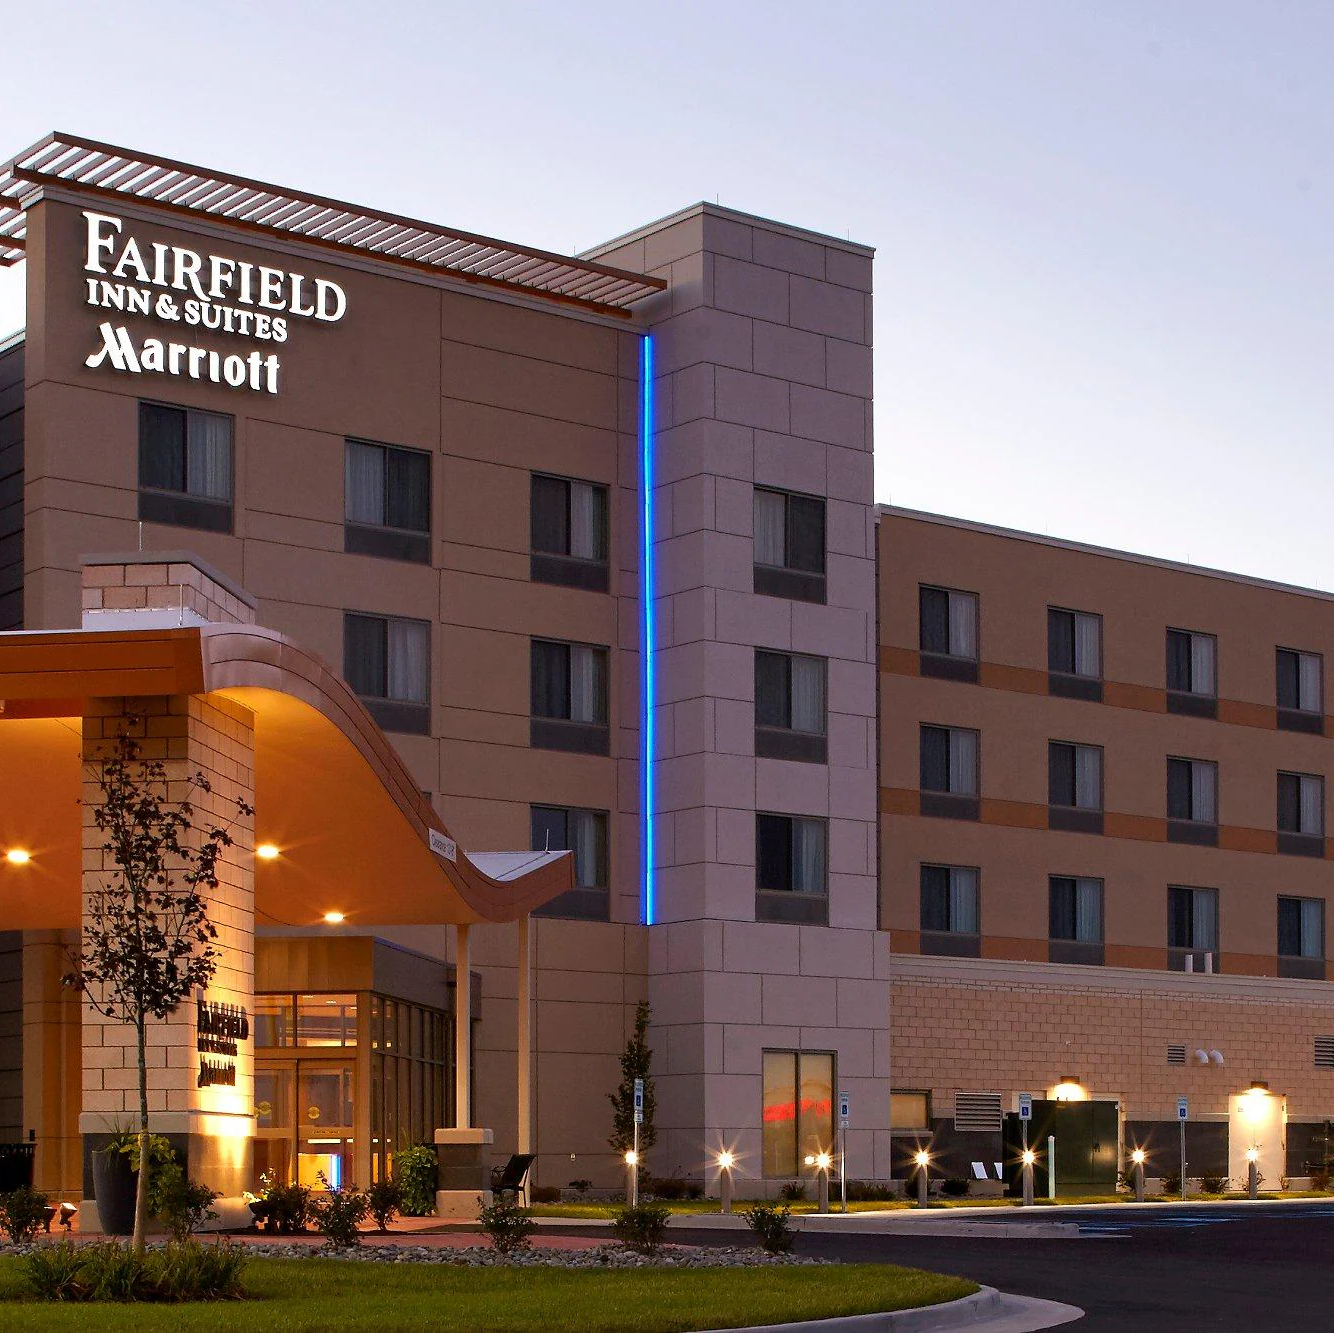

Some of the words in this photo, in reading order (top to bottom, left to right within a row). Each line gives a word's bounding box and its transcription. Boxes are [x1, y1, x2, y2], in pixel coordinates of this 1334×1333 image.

[81, 210, 348, 323] FAIRFIELD
[86, 278, 151, 316] INN
[155, 294, 180, 321] &
[184, 299, 289, 343] SUITES
[85, 322, 281, 395] Marriott
